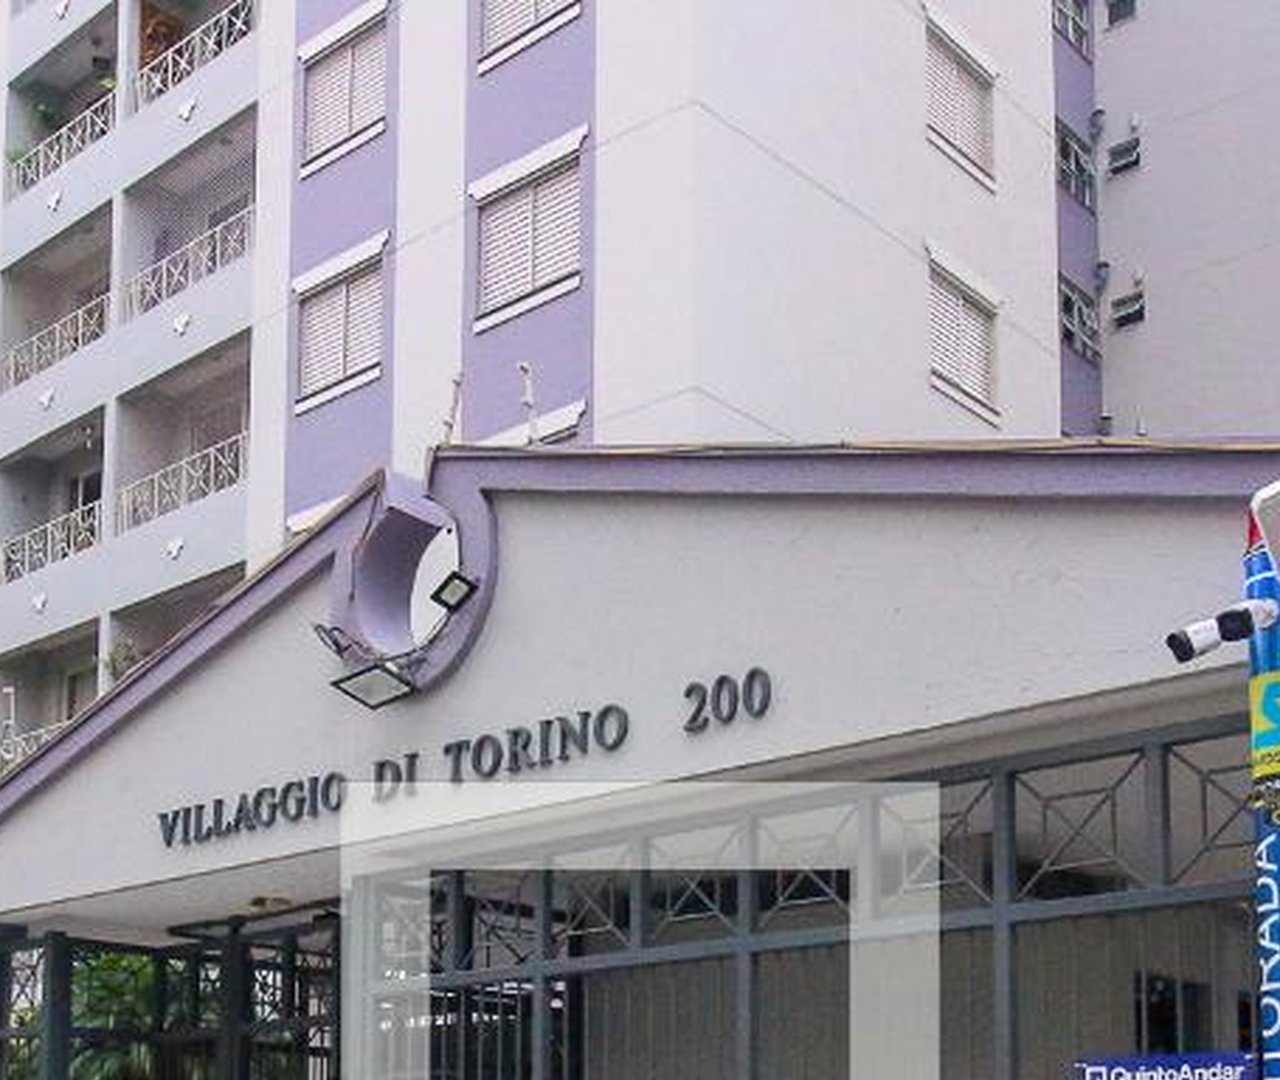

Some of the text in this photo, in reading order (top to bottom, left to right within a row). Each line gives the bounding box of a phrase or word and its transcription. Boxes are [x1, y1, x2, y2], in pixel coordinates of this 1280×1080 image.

[157, 666, 773, 850] VILLAGGIO DI TORINO 200
